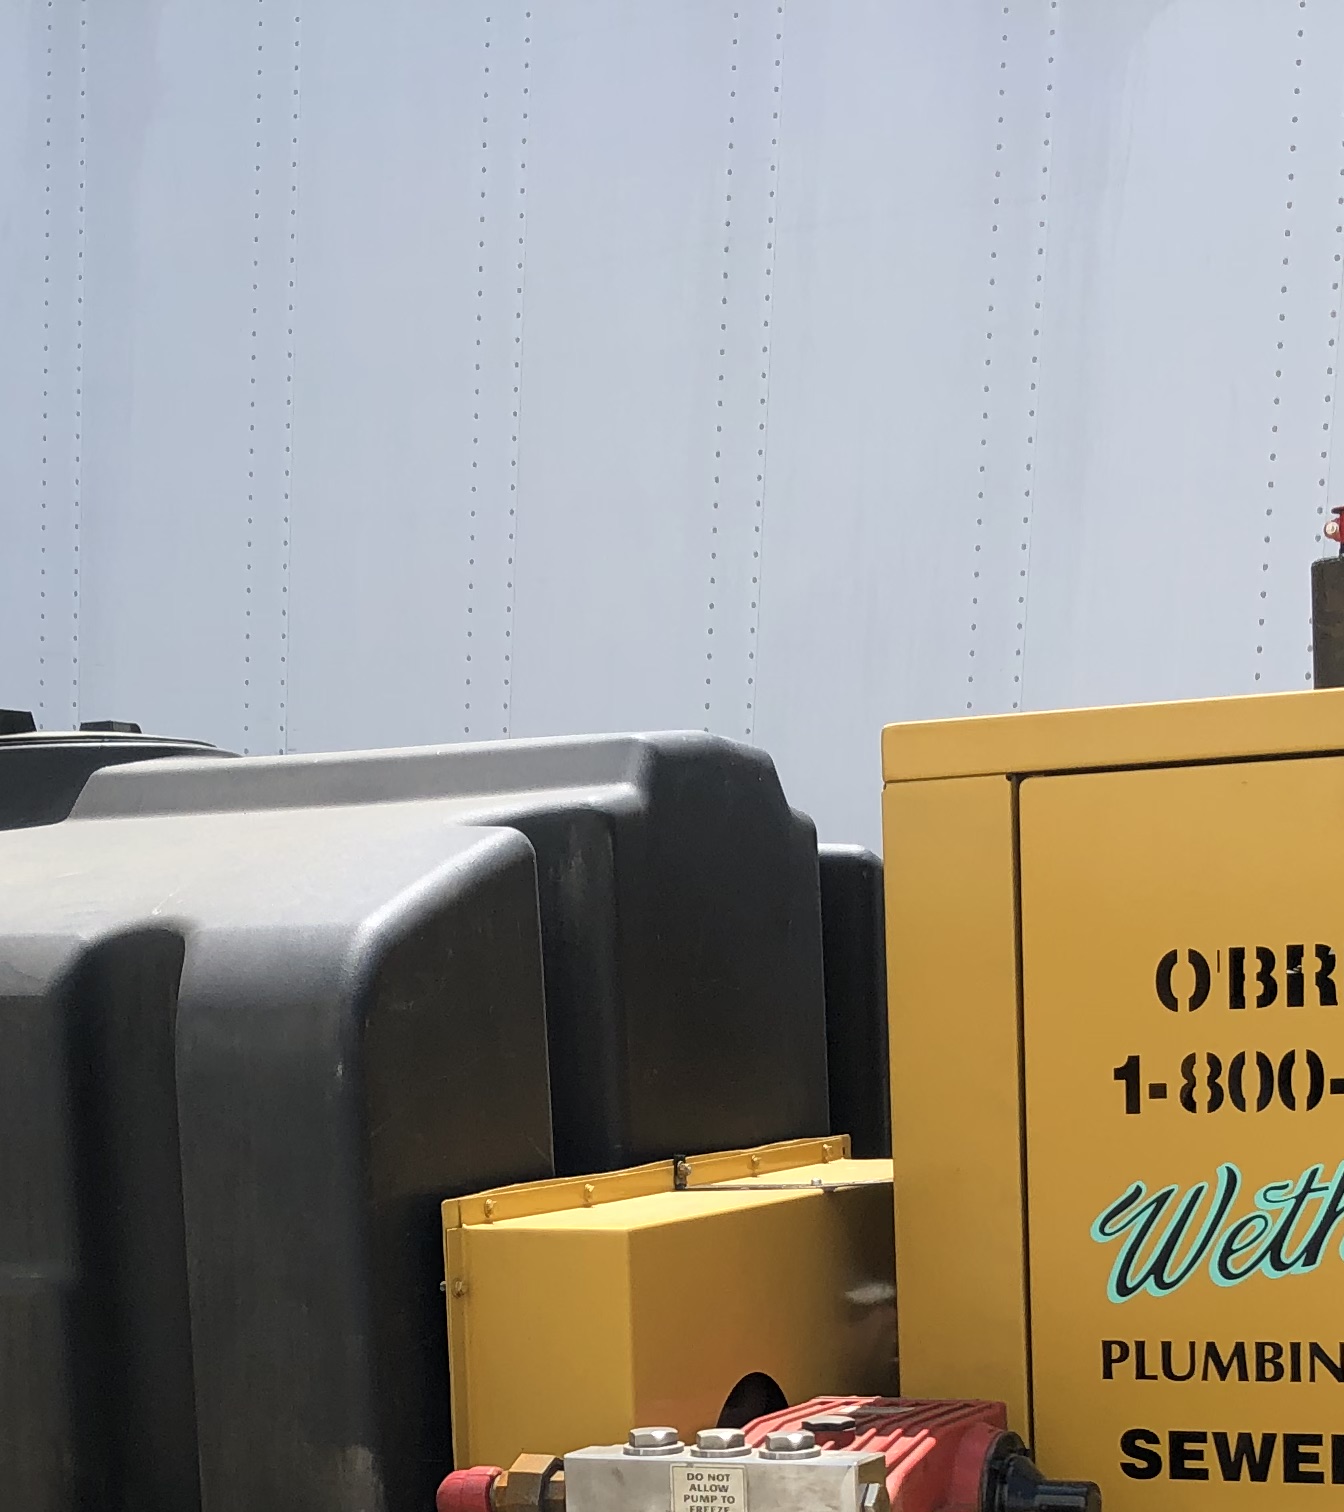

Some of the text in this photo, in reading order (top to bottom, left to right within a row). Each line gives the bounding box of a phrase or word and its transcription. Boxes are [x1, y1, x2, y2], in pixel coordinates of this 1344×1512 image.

[686, 1472, 731, 1482] DO NOT
[689, 1483, 729, 1493] ALLOW
[683, 1493, 735, 1504] PUMP TO
